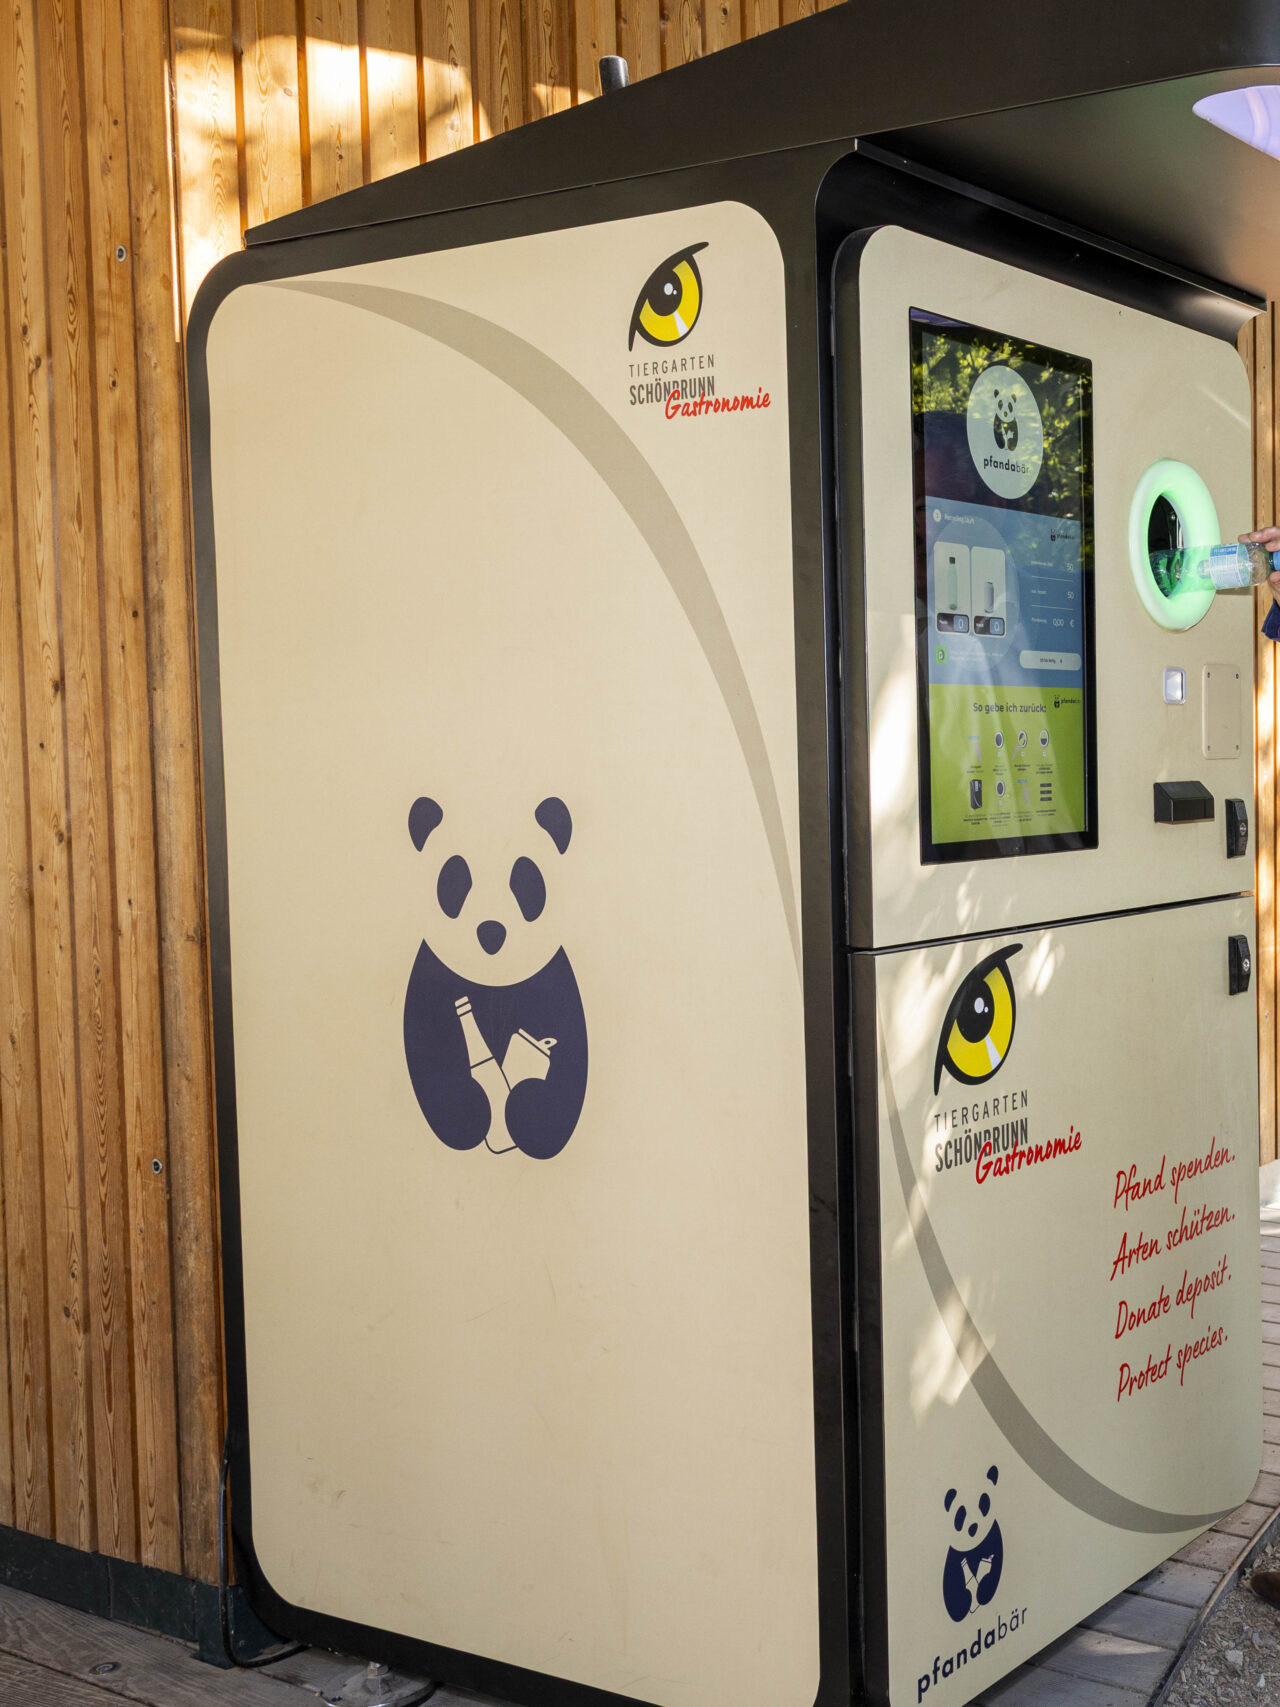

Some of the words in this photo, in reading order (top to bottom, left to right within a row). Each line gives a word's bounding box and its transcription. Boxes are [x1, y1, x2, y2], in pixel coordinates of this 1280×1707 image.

[628, 354, 715, 378] TIERGARTEN
[665, 386, 771, 420] Gastronomie
[972, 702, 983, 713] So
[984, 702, 1005, 715] gebe
[1006, 702, 1018, 713] ich
[934, 1089, 1029, 1133] TIERGARTEN
[975, 1124, 1082, 1185] Gastronomie
[1114, 1154, 1167, 1212] Pfand
[1170, 1136, 1236, 1204] spenden.
[1109, 1231, 1162, 1282] Arten
[1166, 1204, 1236, 1250] schützen.
[1114, 1284, 1171, 1340] Donate
[1175, 1254, 1232, 1319] deposit.
[1117, 1343, 1173, 1403] Protect
[1176, 1325, 1228, 1387] species.
[917, 1607, 1028, 1704] pfandabär
